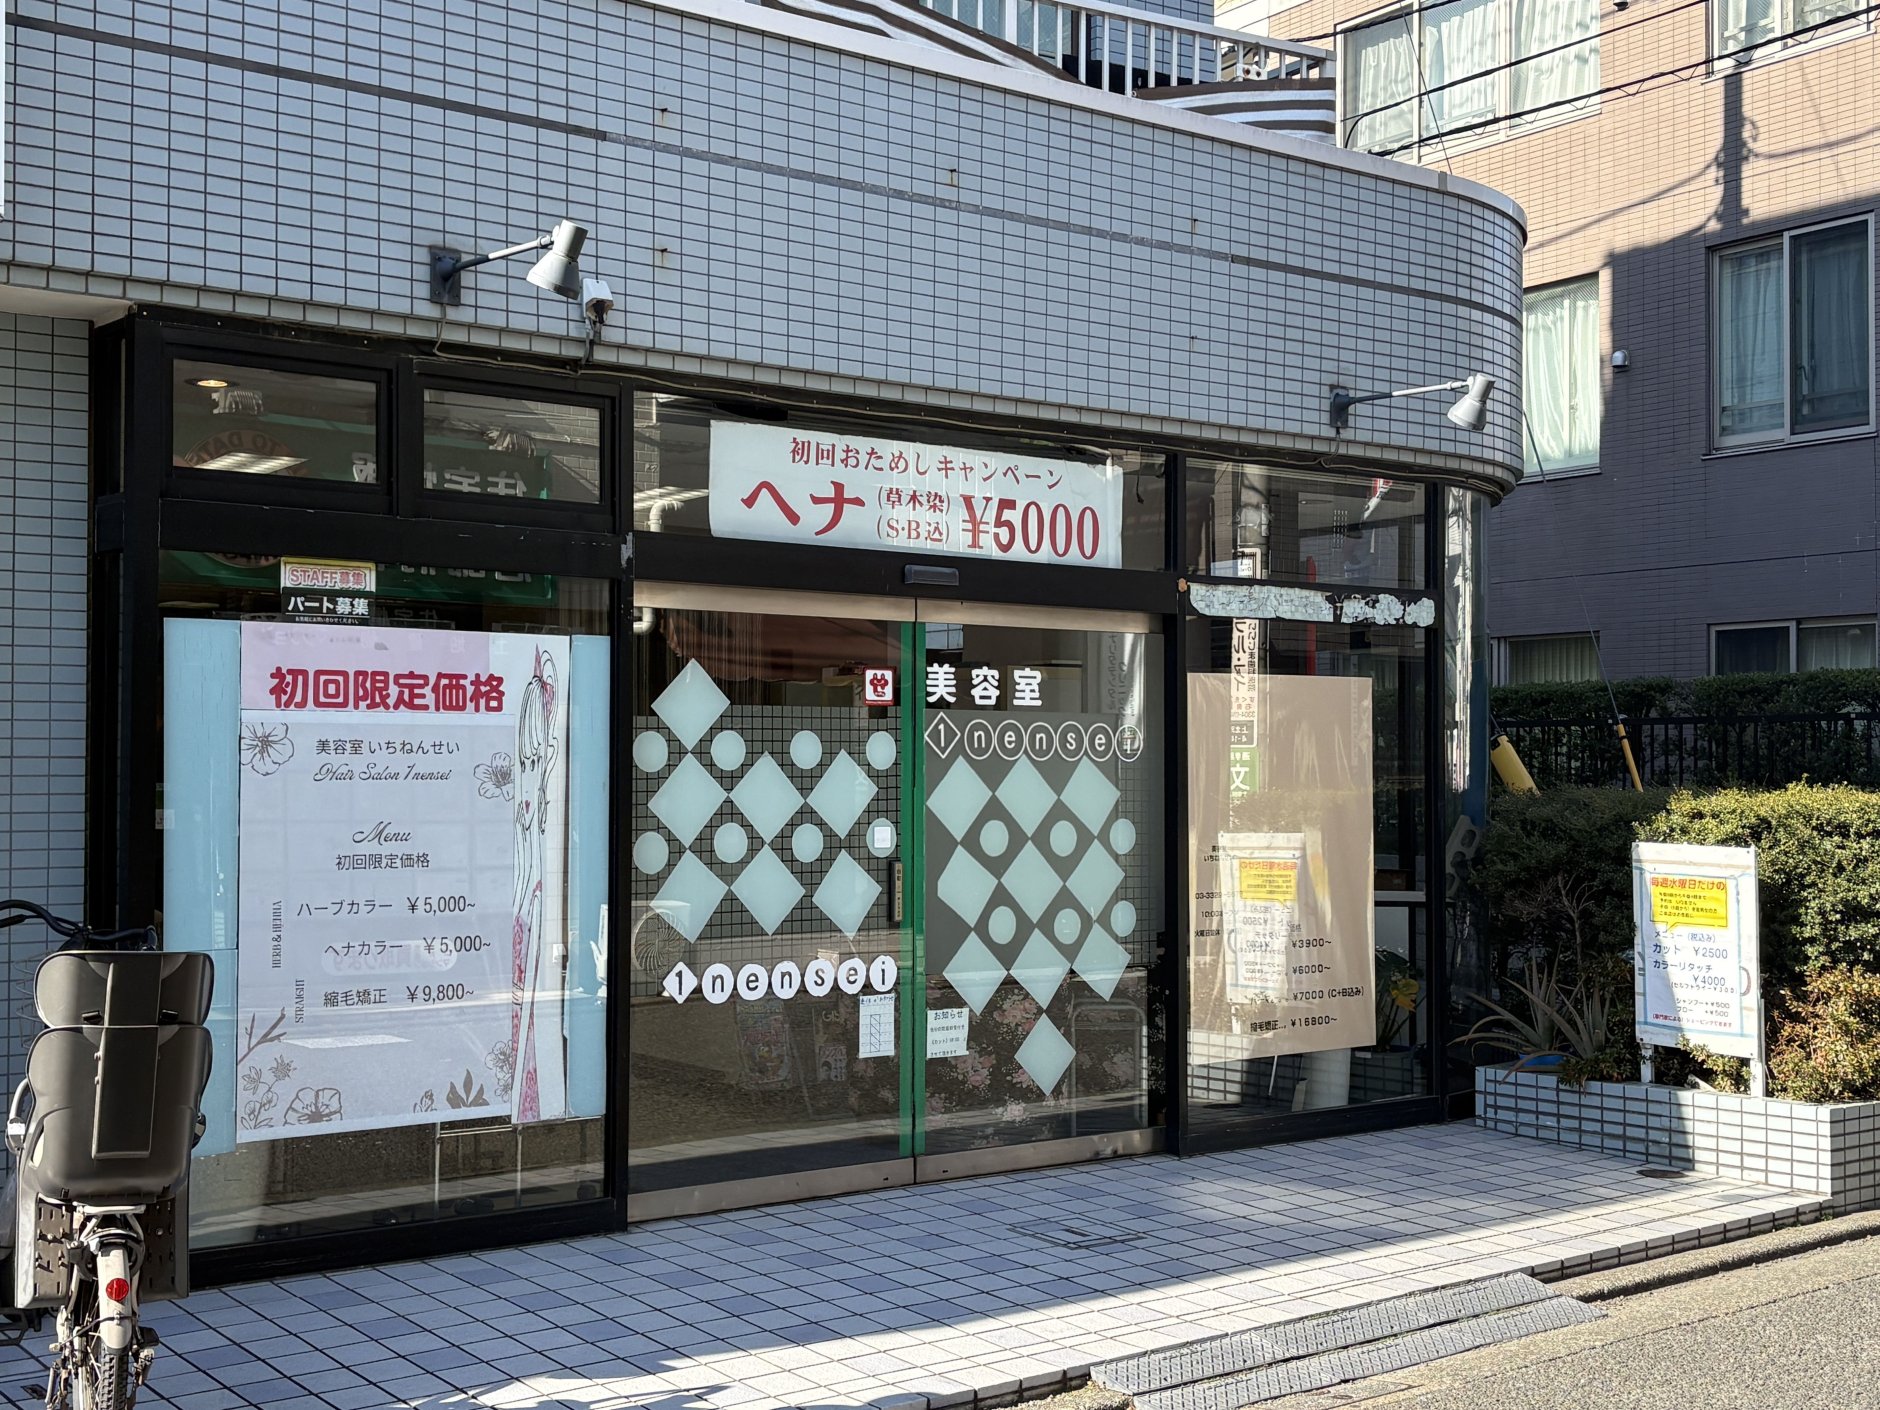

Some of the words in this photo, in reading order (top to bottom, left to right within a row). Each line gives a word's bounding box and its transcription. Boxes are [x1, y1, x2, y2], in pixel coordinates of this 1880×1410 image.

[789, 437, 1064, 491] 初回おためしキャンペーン
[740, 480, 866, 537] ヘナ
[959, 493, 1100, 561] ¥5000
[289, 565, 366, 590] STAFF募集
[287, 596, 369, 616] パート募集
[268, 666, 506, 714] 初回限定価格
[925, 662, 1043, 707] 美容室
[315, 738, 364, 755] 美容室
[368, 740, 460, 756] いちねんせい
[313, 762, 354, 782] Hair
[358, 762, 401, 782] Salon
[352, 820, 412, 846] Menu
[335, 852, 430, 872] 初回限定価格
[1651, 877, 1726, 891] 毎週水曜日だけの
[296, 898, 393, 918] ハーブカラー
[324, 940, 403, 957] ヘナカラー
[1652, 943, 1681, 955] カット
[1693, 946, 1728, 960] ¥2500
[1653, 959, 1713, 974] カラーリタッチ
[668, 959, 893, 1000] 1nensei
[1692, 974, 1726, 987] ¥4000
[323, 988, 388, 1008] 縮毛矯正
[1292, 989, 1324, 1001] ¥7000
[934, 1010, 963, 1021] お知らせ
